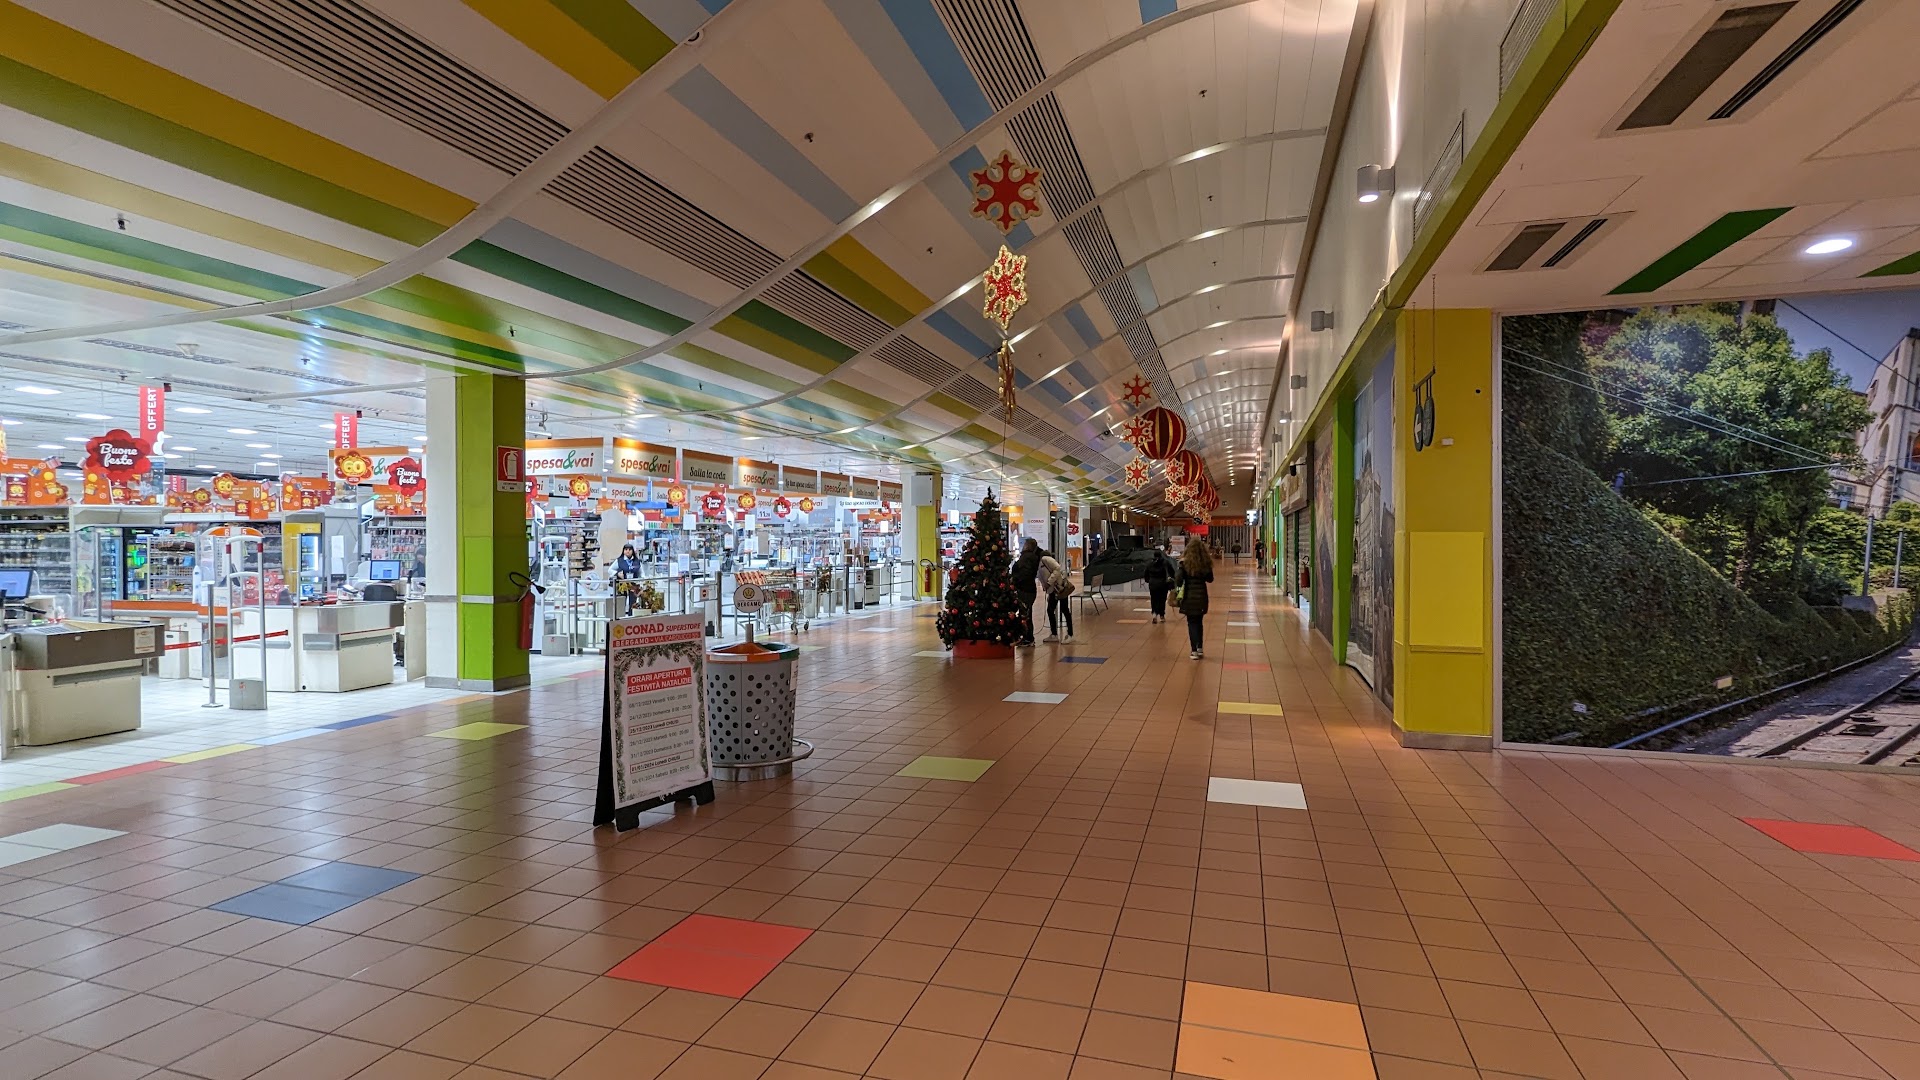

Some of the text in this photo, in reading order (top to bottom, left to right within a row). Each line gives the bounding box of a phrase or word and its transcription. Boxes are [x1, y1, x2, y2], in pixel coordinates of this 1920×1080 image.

[99, 443, 138, 456] Buone
[104, 454, 133, 467] feste
[526, 450, 594, 473] spesa&vai
[620, 455, 671, 473] spesa&vai
[396, 467, 420, 477] Buone
[743, 471, 776, 485] spesa&vai
[399, 476, 417, 485] feste
[252, 487, 260, 499] 18
[395, 493, 402, 504] 16
[611, 486, 645, 498] spesa&vai
[625, 622, 702, 636] CONAD SUPERSTORE
[615, 637, 649, 647] BERGAMO
[655, 635, 664, 643] VIA
[631, 669, 687, 684] ORARI APERTURA
[627, 676, 692, 694] FESTIVITÀ NATALIZIE
